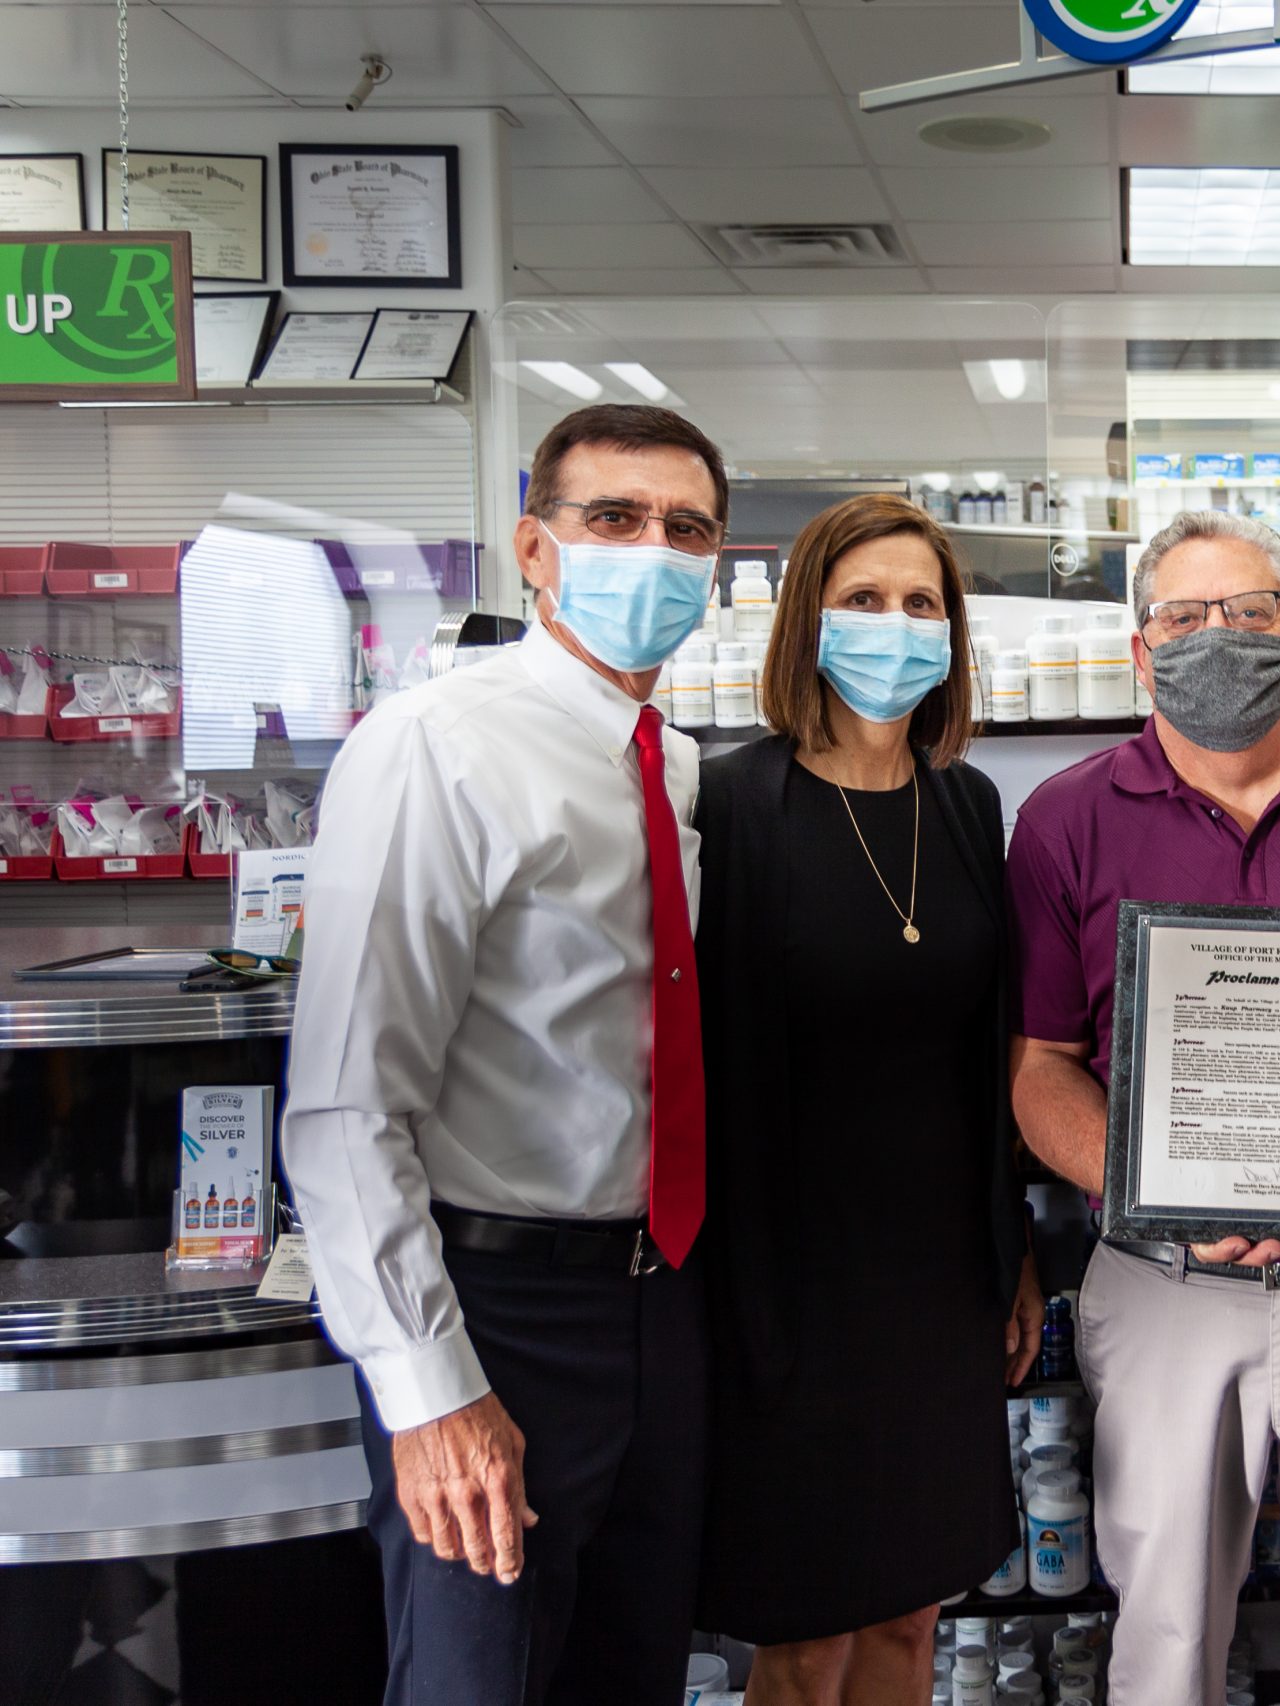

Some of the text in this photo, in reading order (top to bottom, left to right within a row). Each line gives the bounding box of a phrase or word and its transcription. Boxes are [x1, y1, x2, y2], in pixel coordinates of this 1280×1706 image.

[310, 170, 331, 185] Ohio
[354, 160, 380, 172] Board
[390, 162, 429, 187] Pharmacy
[6, 293, 73, 334] UP
[1190, 944, 1232, 953] VILLAGE
[1235, 945, 1248, 953] OF
[1250, 946, 1275, 955] FORT
[1214, 954, 1243, 962] OFFICE
[200, 1115, 245, 1123] DISCOVER
[200, 1129, 245, 1140] SILVER
[1036, 1551, 1065, 1567] GABA
